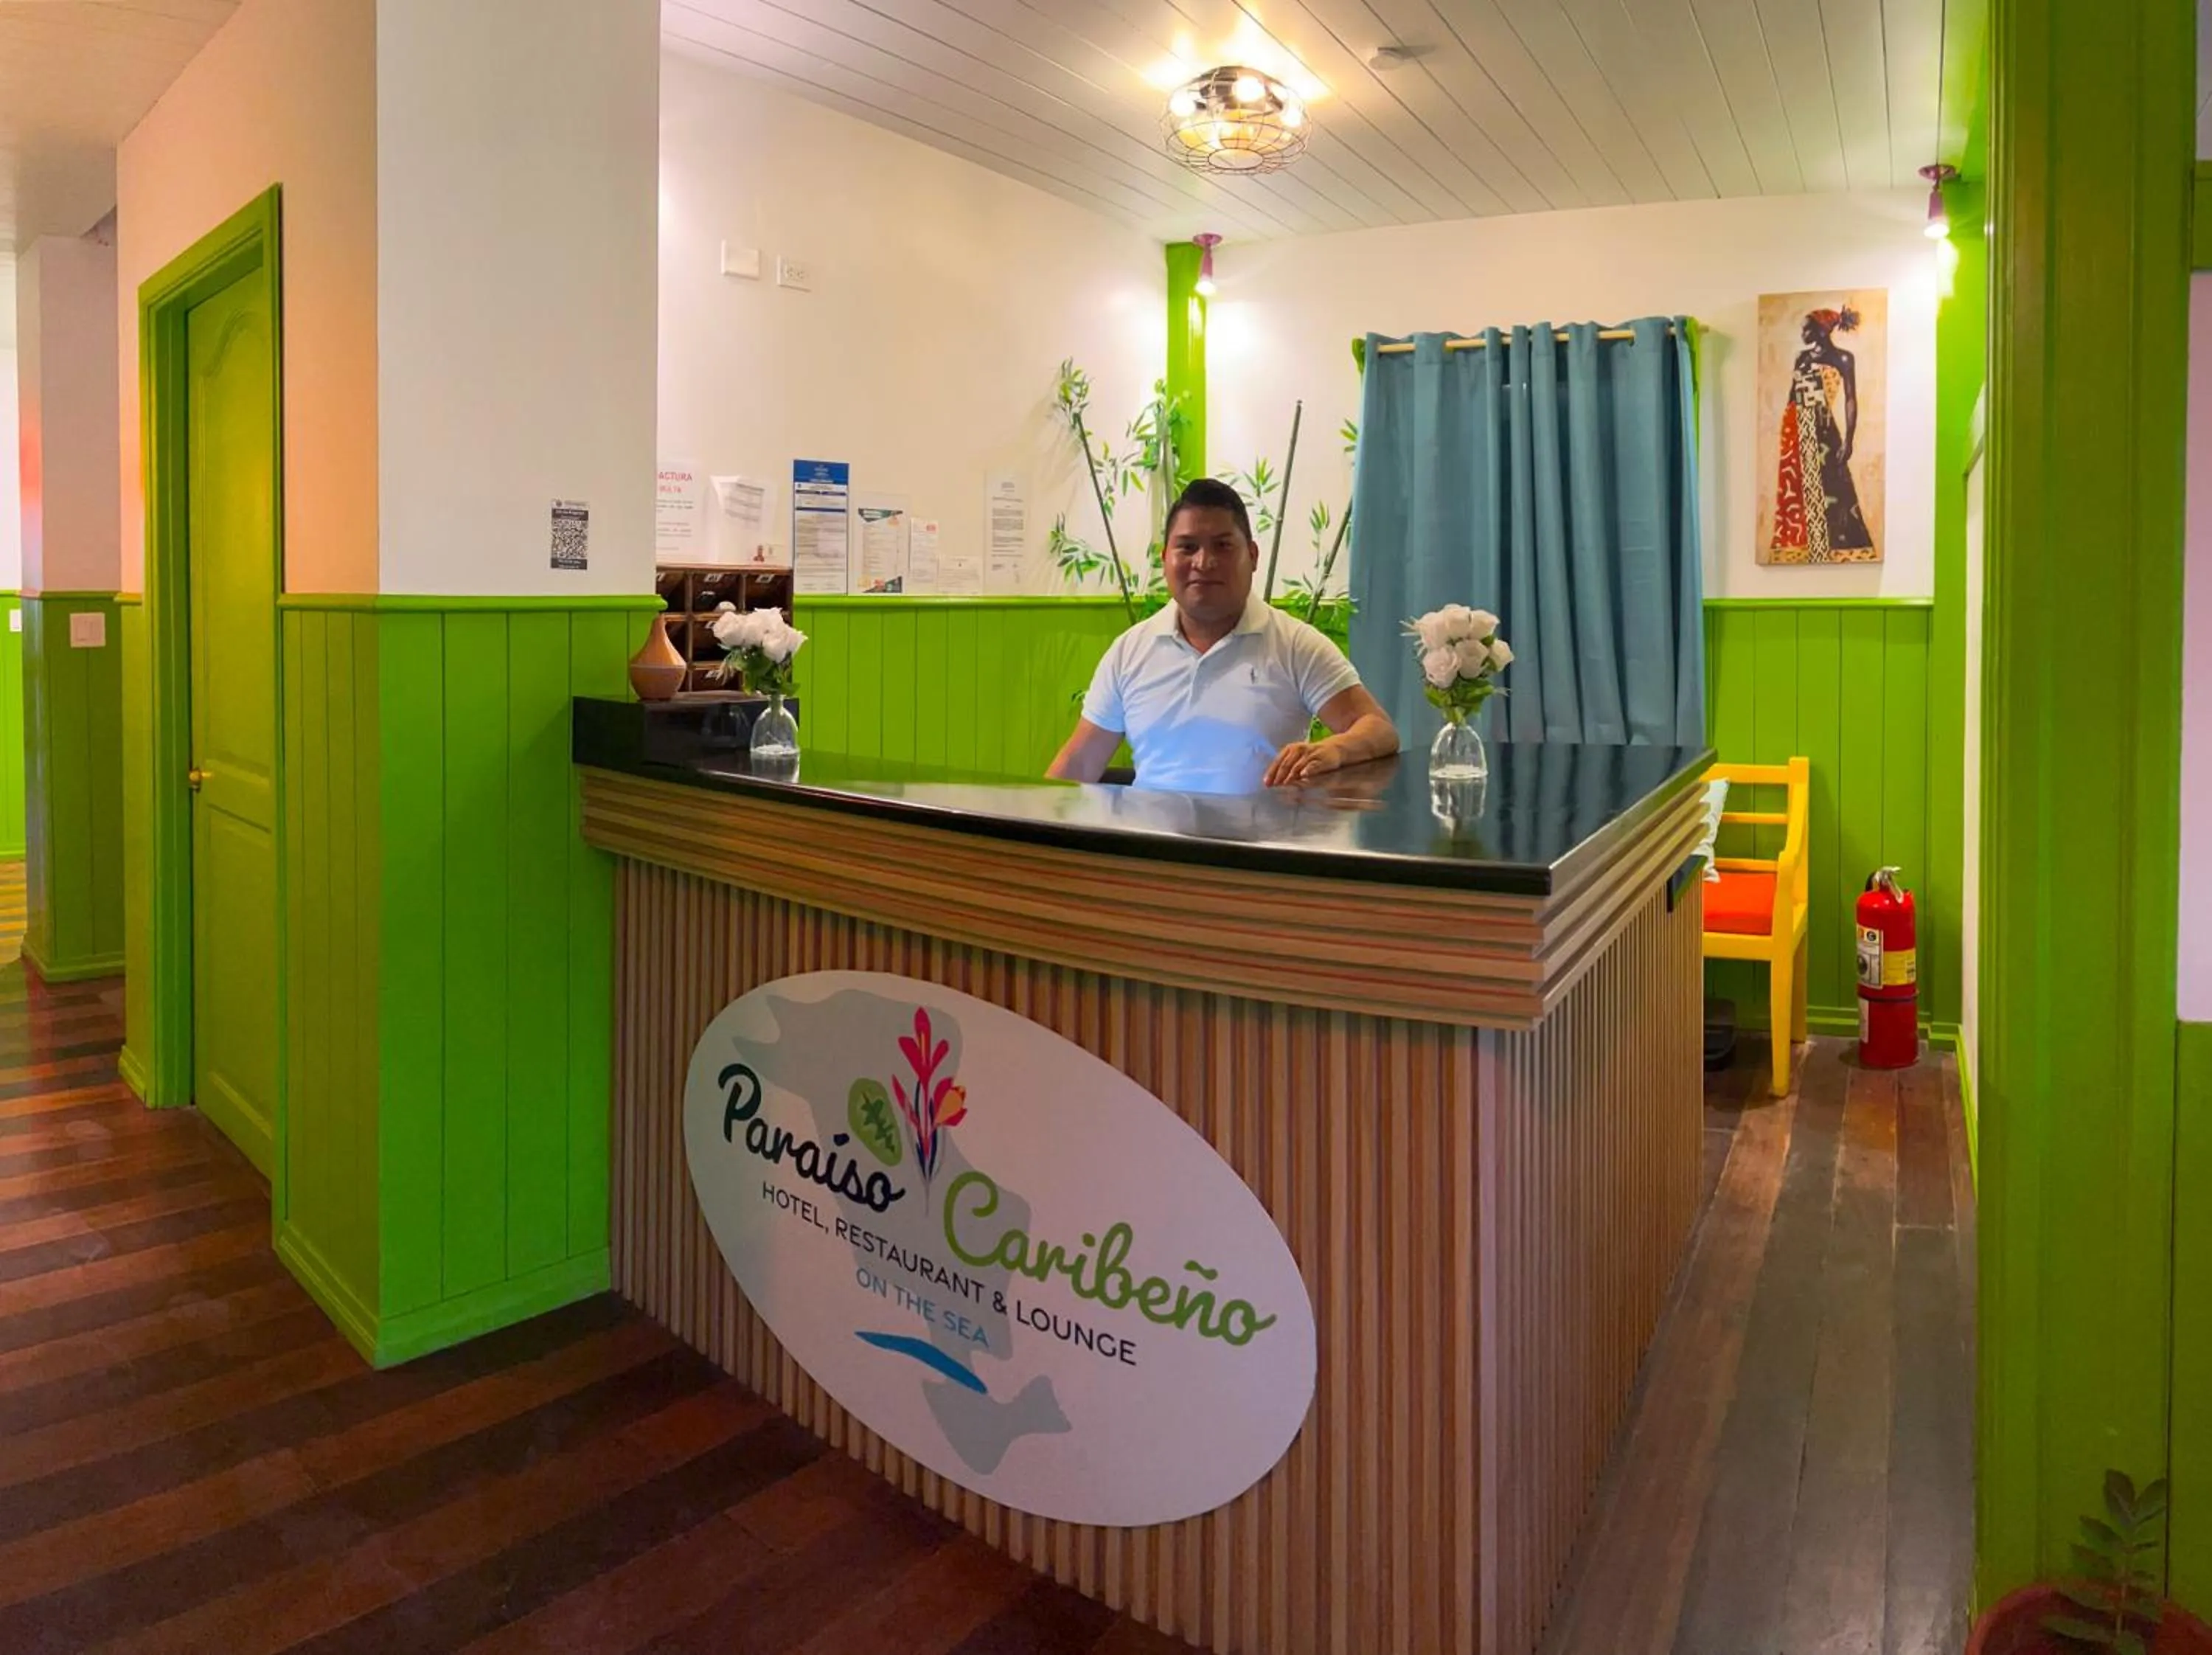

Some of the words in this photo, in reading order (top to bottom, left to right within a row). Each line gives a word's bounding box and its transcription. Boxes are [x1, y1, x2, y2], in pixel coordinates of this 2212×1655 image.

[658, 471, 693, 482] ACTURA
[762, 1181, 830, 1235] HOTEL,
[835, 1218, 985, 1304] RESTAURANT
[992, 1291, 1008, 1316] &
[1016, 1300, 1137, 1366] LOUNGE
[855, 1267, 887, 1299] ON
[894, 1285, 936, 1322] THE
[942, 1310, 990, 1348] SEA
[944, 1171, 1277, 1346] Caribeño
